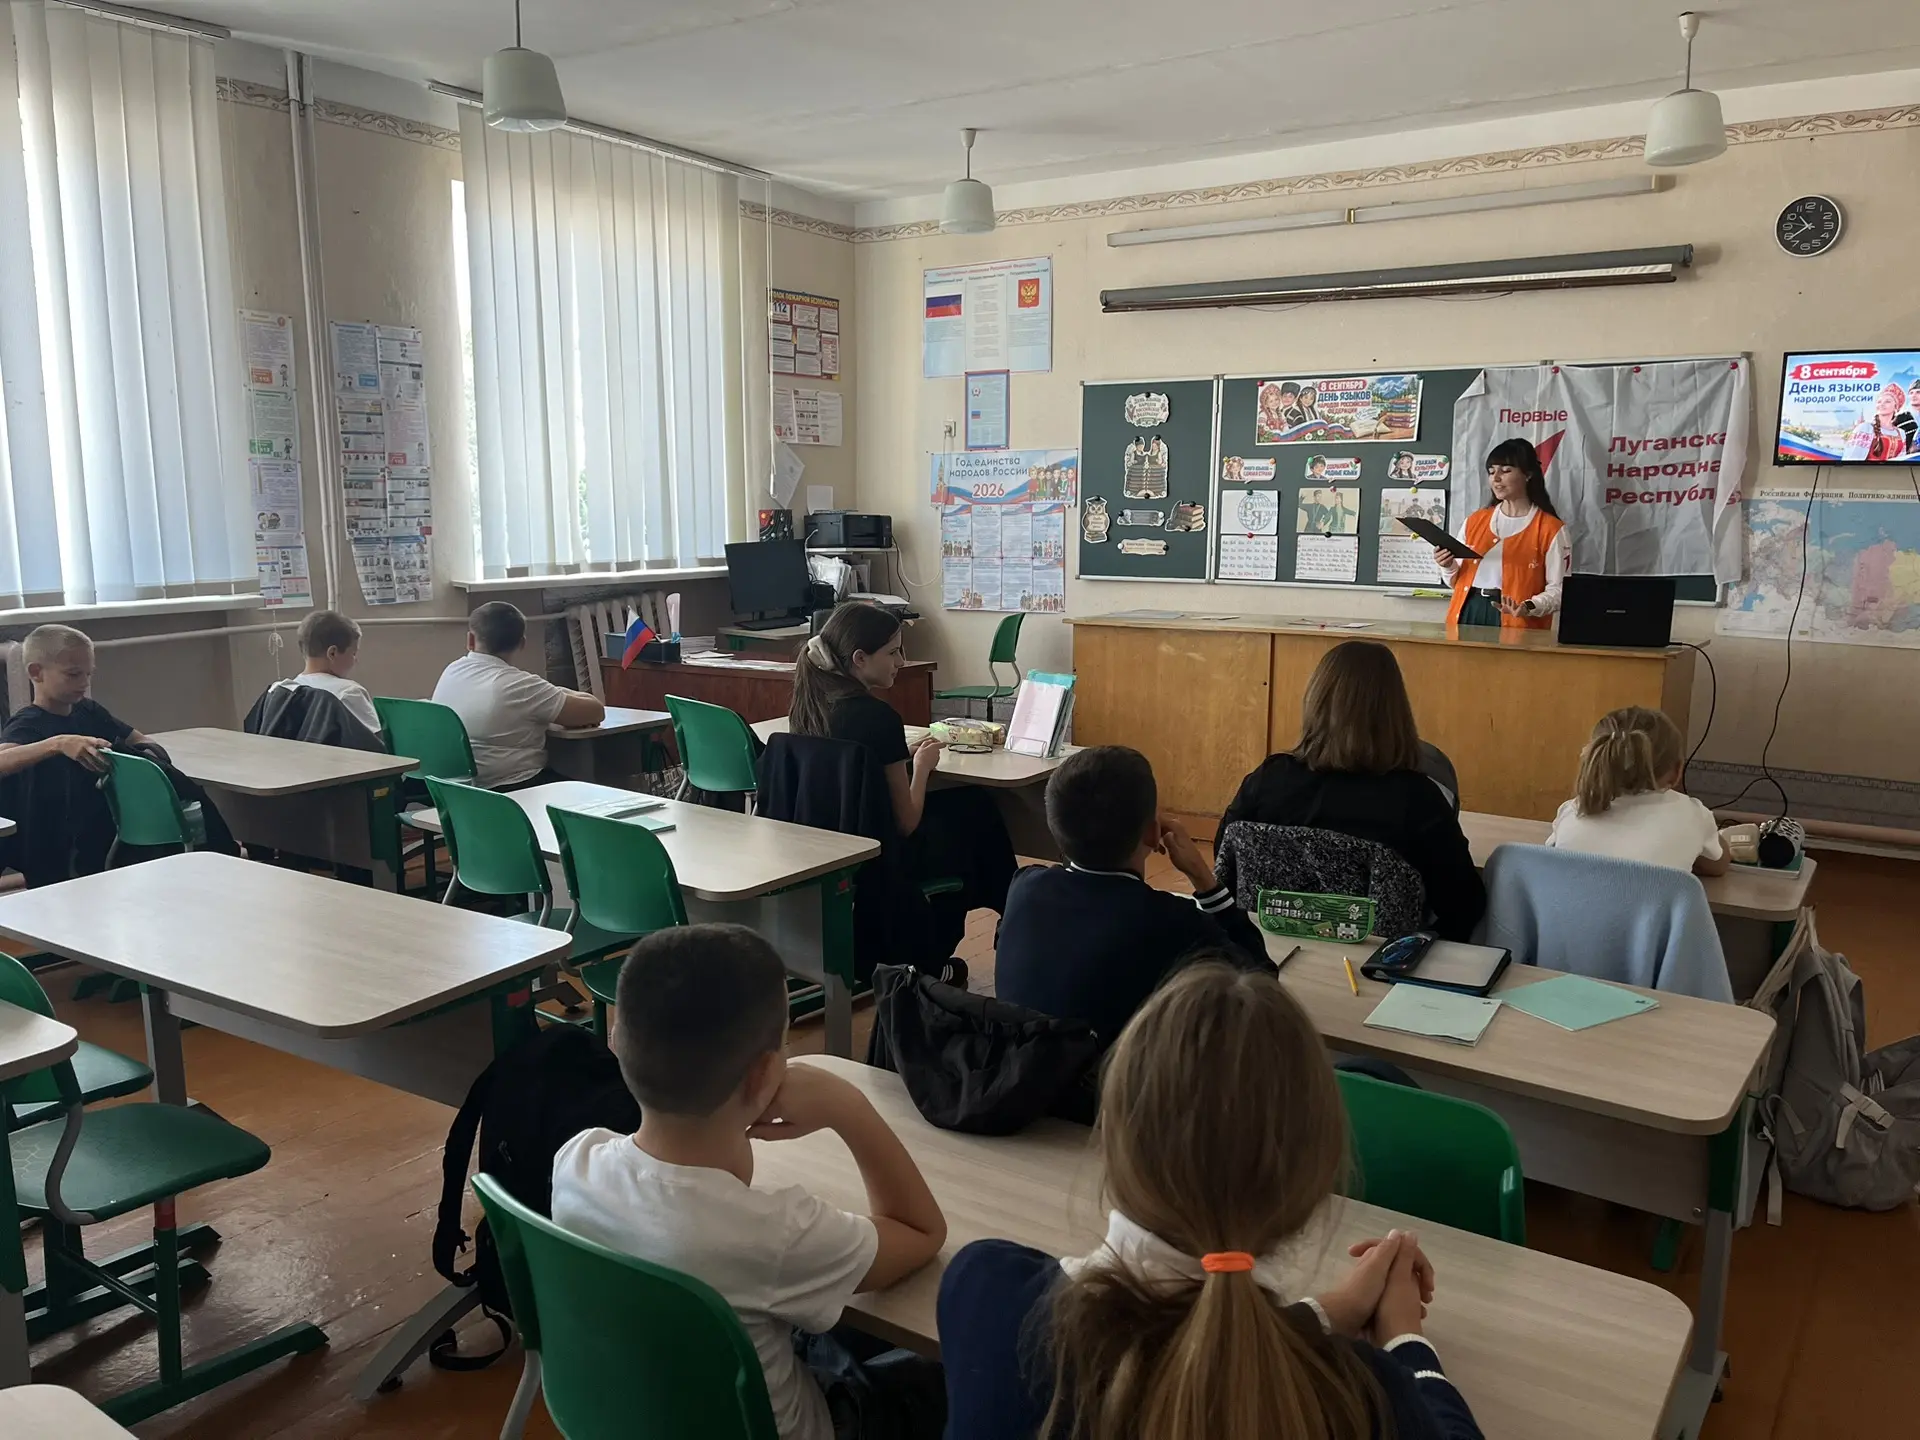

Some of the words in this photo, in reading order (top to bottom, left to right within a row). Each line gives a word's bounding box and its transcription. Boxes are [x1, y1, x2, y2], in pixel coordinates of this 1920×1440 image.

[1824, 222, 1834, 230] 3
[1784, 232, 1794, 240] 8
[774, 302, 787, 313] 112
[1800, 365, 1811, 379] 8
[1813, 365, 1867, 378] сентября
[1320, 382, 1326, 391] 8
[1328, 380, 1364, 390] СЕНТЯБРЯ
[1789, 382, 1825, 395] День
[1828, 383, 1880, 393] языков
[1318, 393, 1339, 402] ДЕНЬ
[1339, 391, 1371, 401] ЯЗЫКОВ
[1794, 396, 1836, 405] народов
[1839, 394, 1873, 402] России
[1499, 408, 1568, 426] Первые
[1608, 432, 1727, 456] Луганска
[955, 458, 972, 468] Год
[974, 457, 1021, 467] единства
[949, 468, 990, 479] народов
[993, 467, 1028, 476] России
[1607, 460, 1721, 480] Народна
[973, 483, 1005, 497] 2026
[1605, 484, 1715, 506] Республ
[1267, 899, 1290, 908] МОИ
[1265, 906, 1322, 920] ПРАВИЛА
